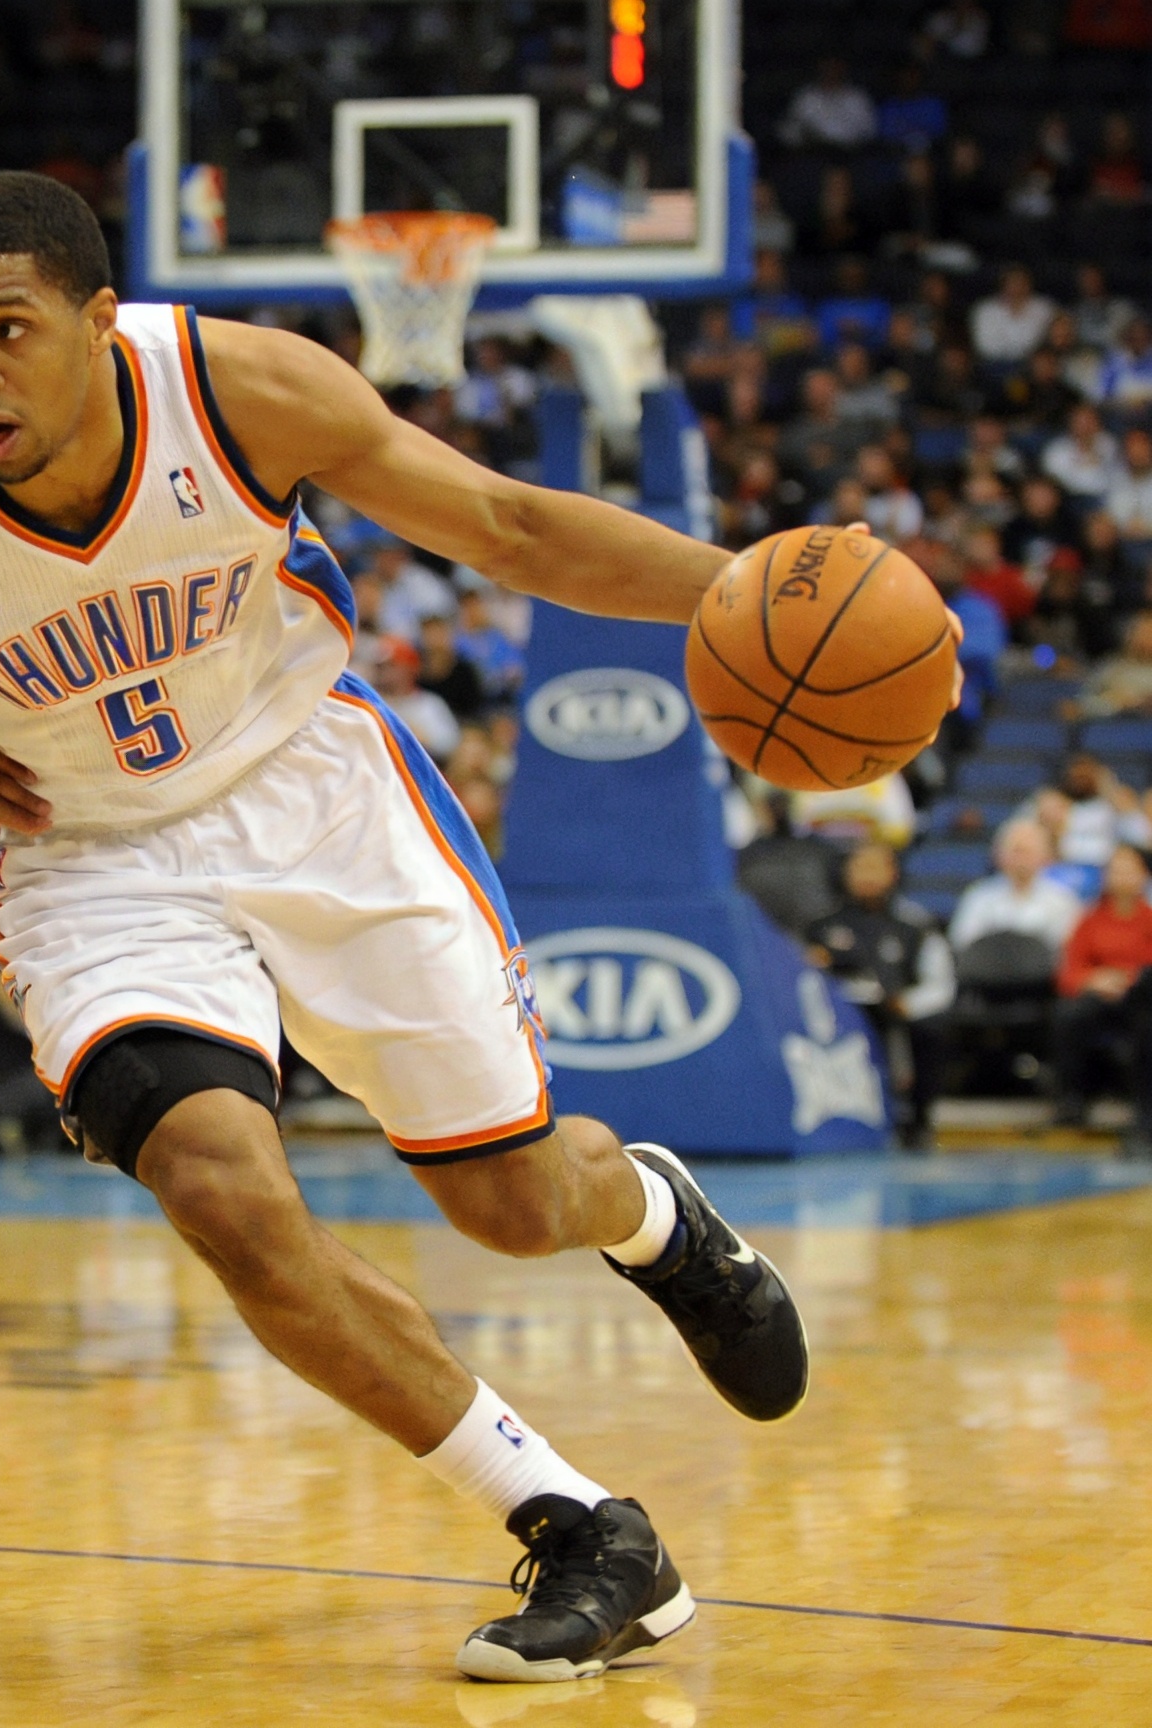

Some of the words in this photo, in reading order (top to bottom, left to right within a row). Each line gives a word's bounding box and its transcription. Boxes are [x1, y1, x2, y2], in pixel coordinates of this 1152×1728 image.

[96, 676, 191, 777] 5
[558, 692, 660, 739] KIA
[534, 957, 694, 1041] KIA
